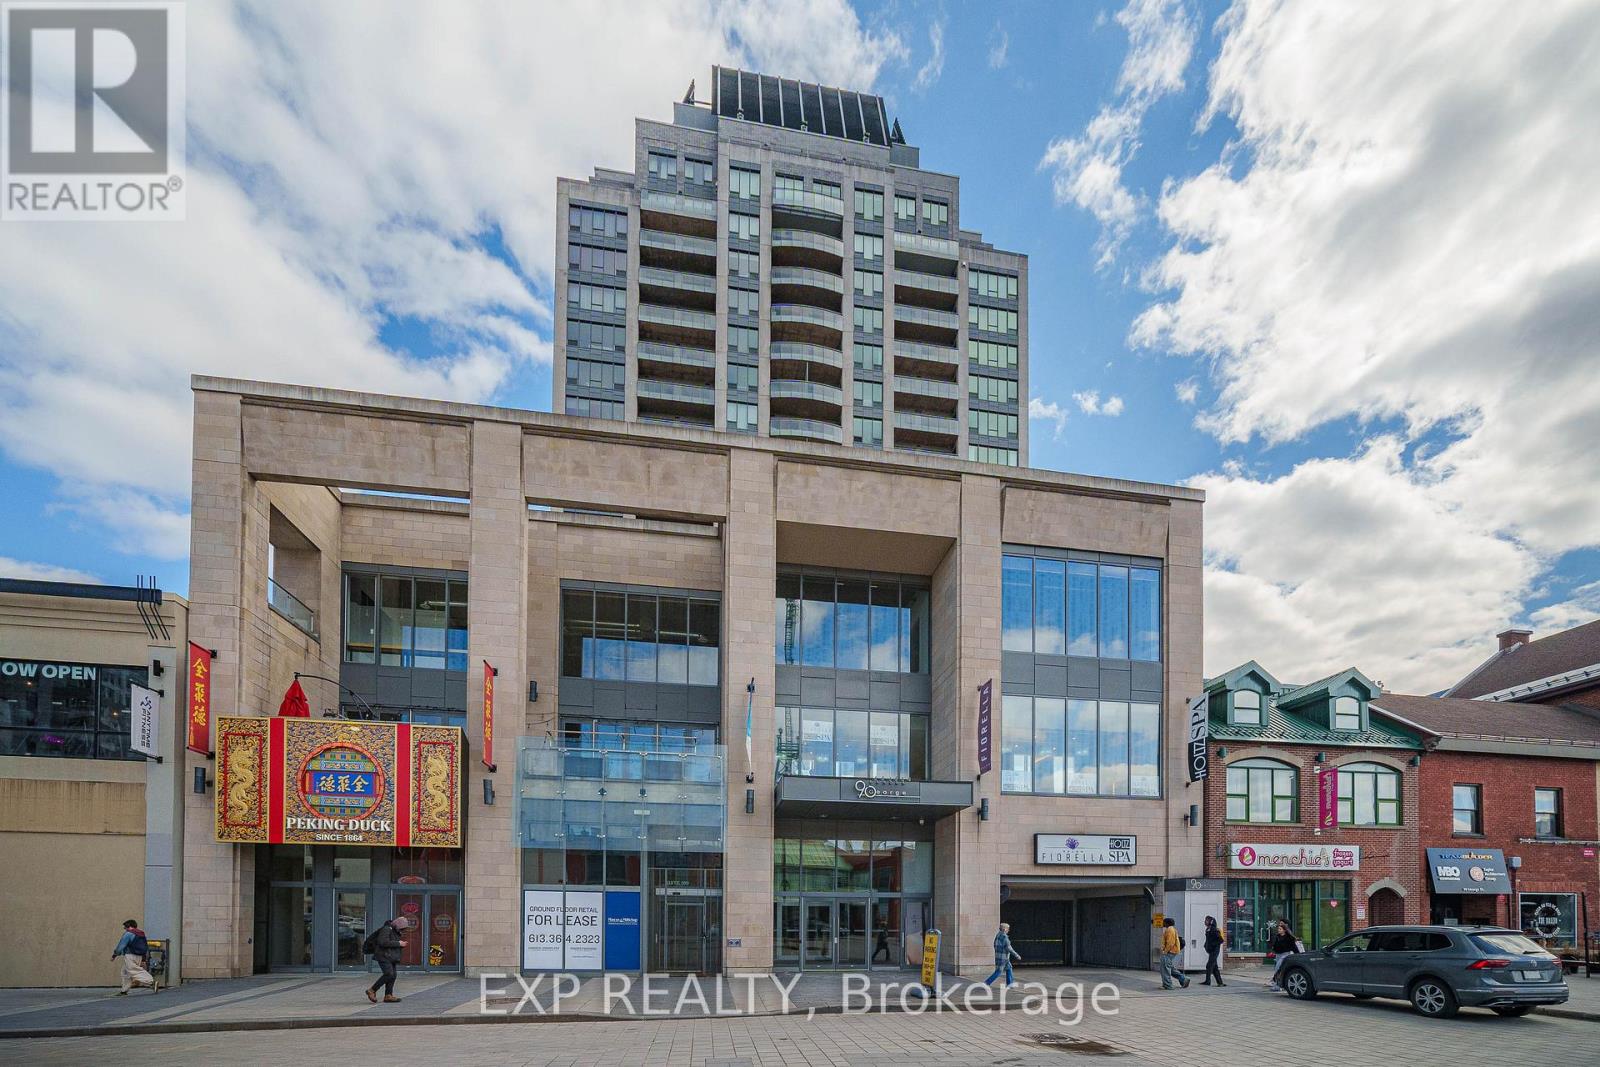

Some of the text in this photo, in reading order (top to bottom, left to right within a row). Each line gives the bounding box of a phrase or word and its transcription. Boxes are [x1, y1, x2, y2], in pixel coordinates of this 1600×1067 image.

[42, 665, 96, 680] OPEN
[981, 686, 989, 762] FIORELLA
[1191, 698, 1206, 740] SPA
[855, 780, 876, 798] 90
[286, 817, 392, 832] PEKING DUCK
[344, 834, 363, 842] 1864
[1042, 850, 1131, 862] FIORELLA SPA
[527, 915, 552, 925] FOR
[556, 915, 597, 926] LEASE
[528, 934, 600, 944] 613.364.2323
